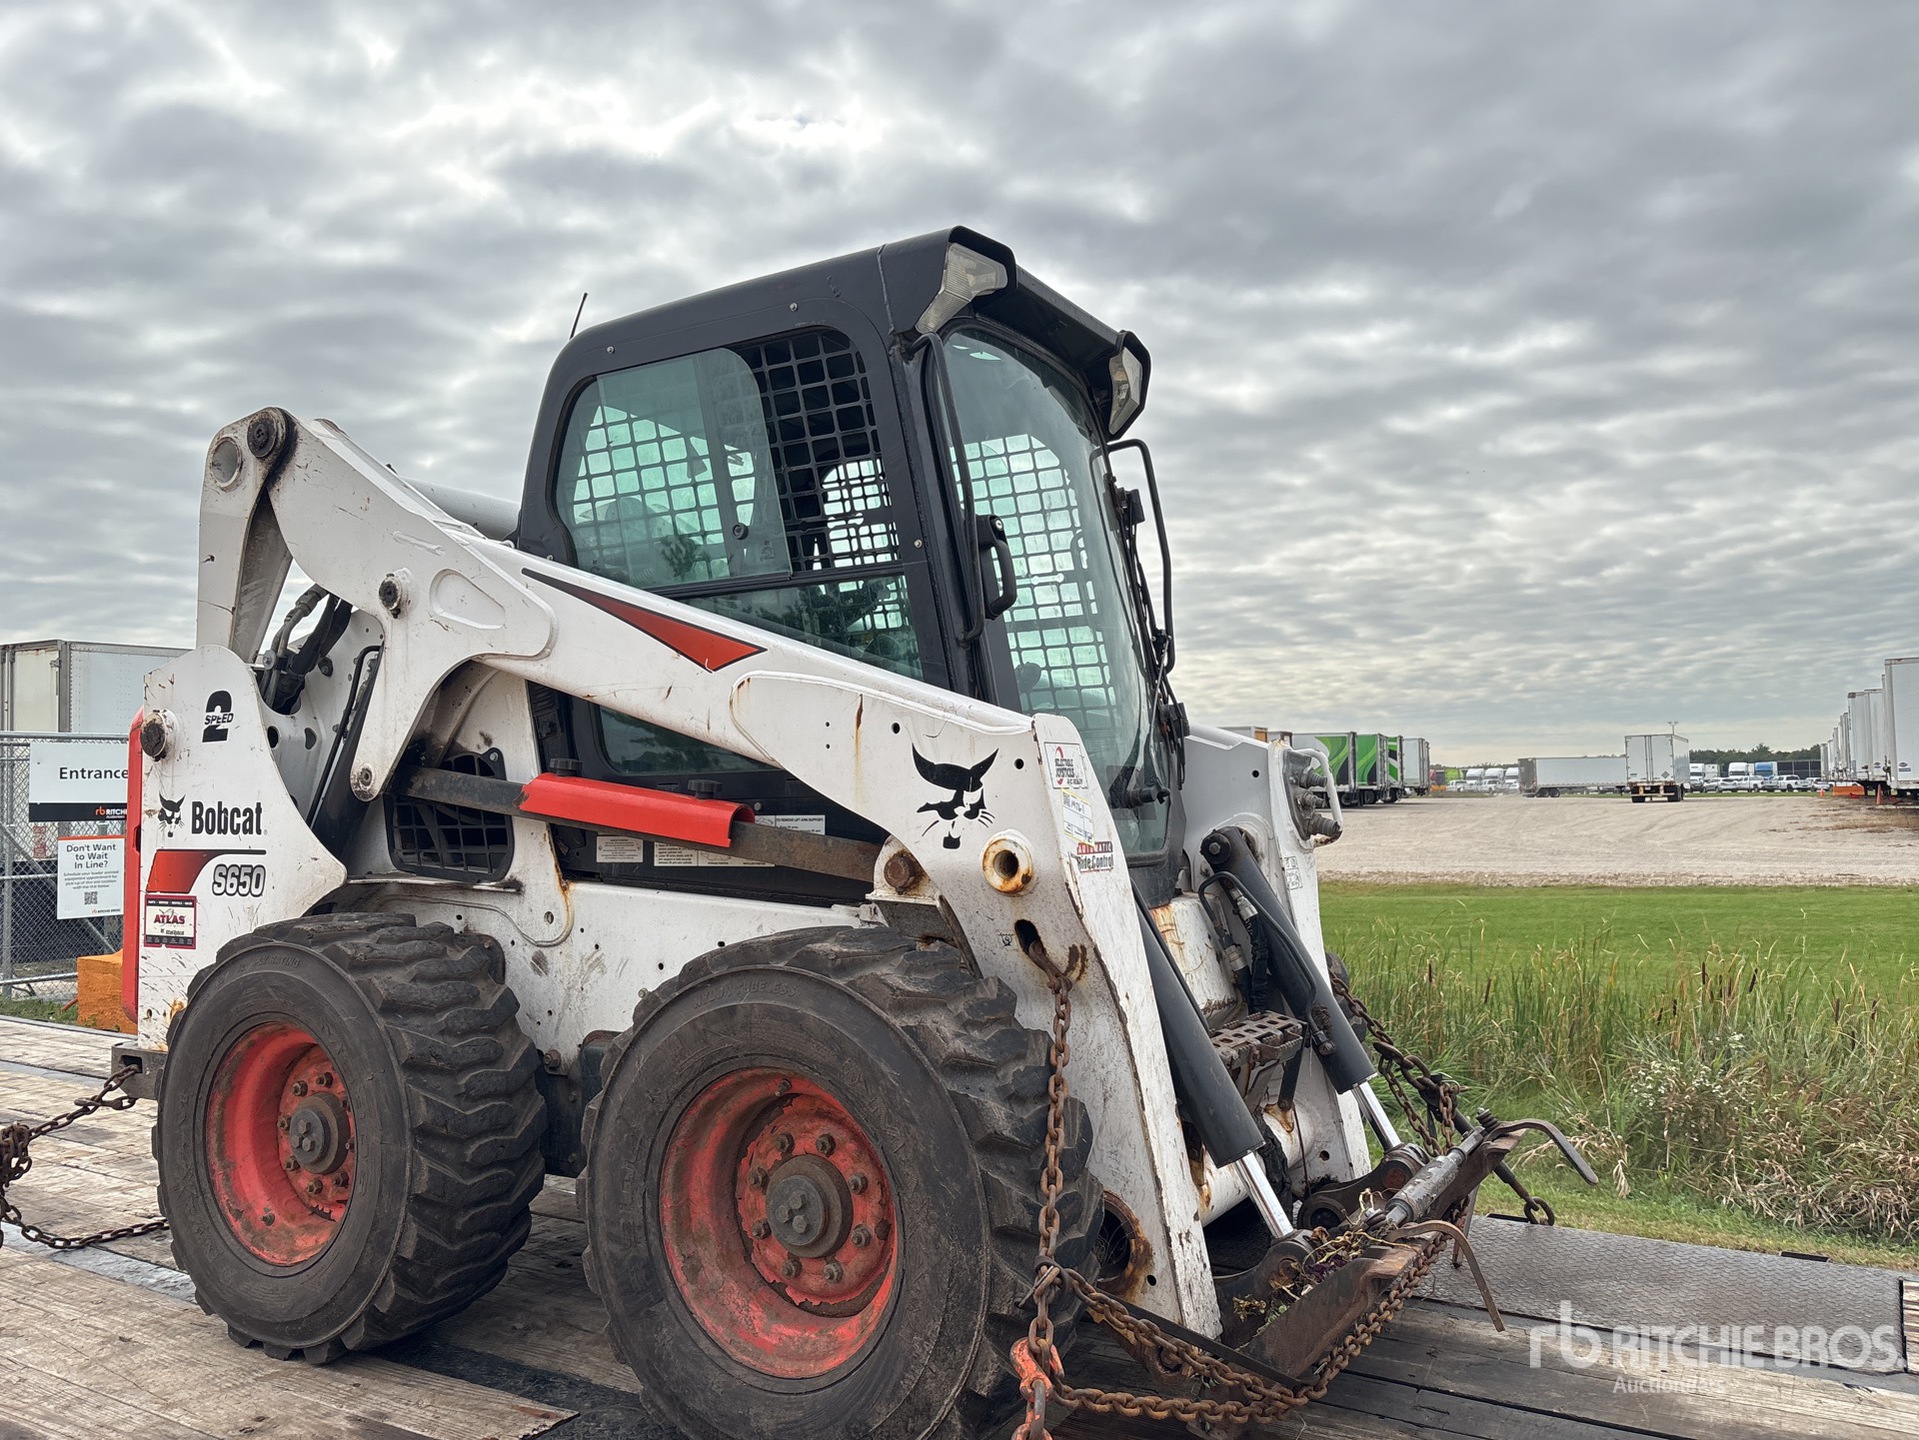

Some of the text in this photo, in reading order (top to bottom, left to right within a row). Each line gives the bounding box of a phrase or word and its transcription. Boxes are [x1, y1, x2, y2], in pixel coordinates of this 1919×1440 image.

[202, 690, 234, 743] 2 SPEED
[59, 767, 129, 780] Entrance
[106, 808, 129, 816] RITCHI
[191, 801, 263, 836] Bobcat
[66, 843, 116, 853] Don't Want
[87, 852, 108, 860] Wait
[86, 860, 109, 869] Line?
[212, 863, 266, 897] S650
[153, 914, 186, 925] ATLAS
